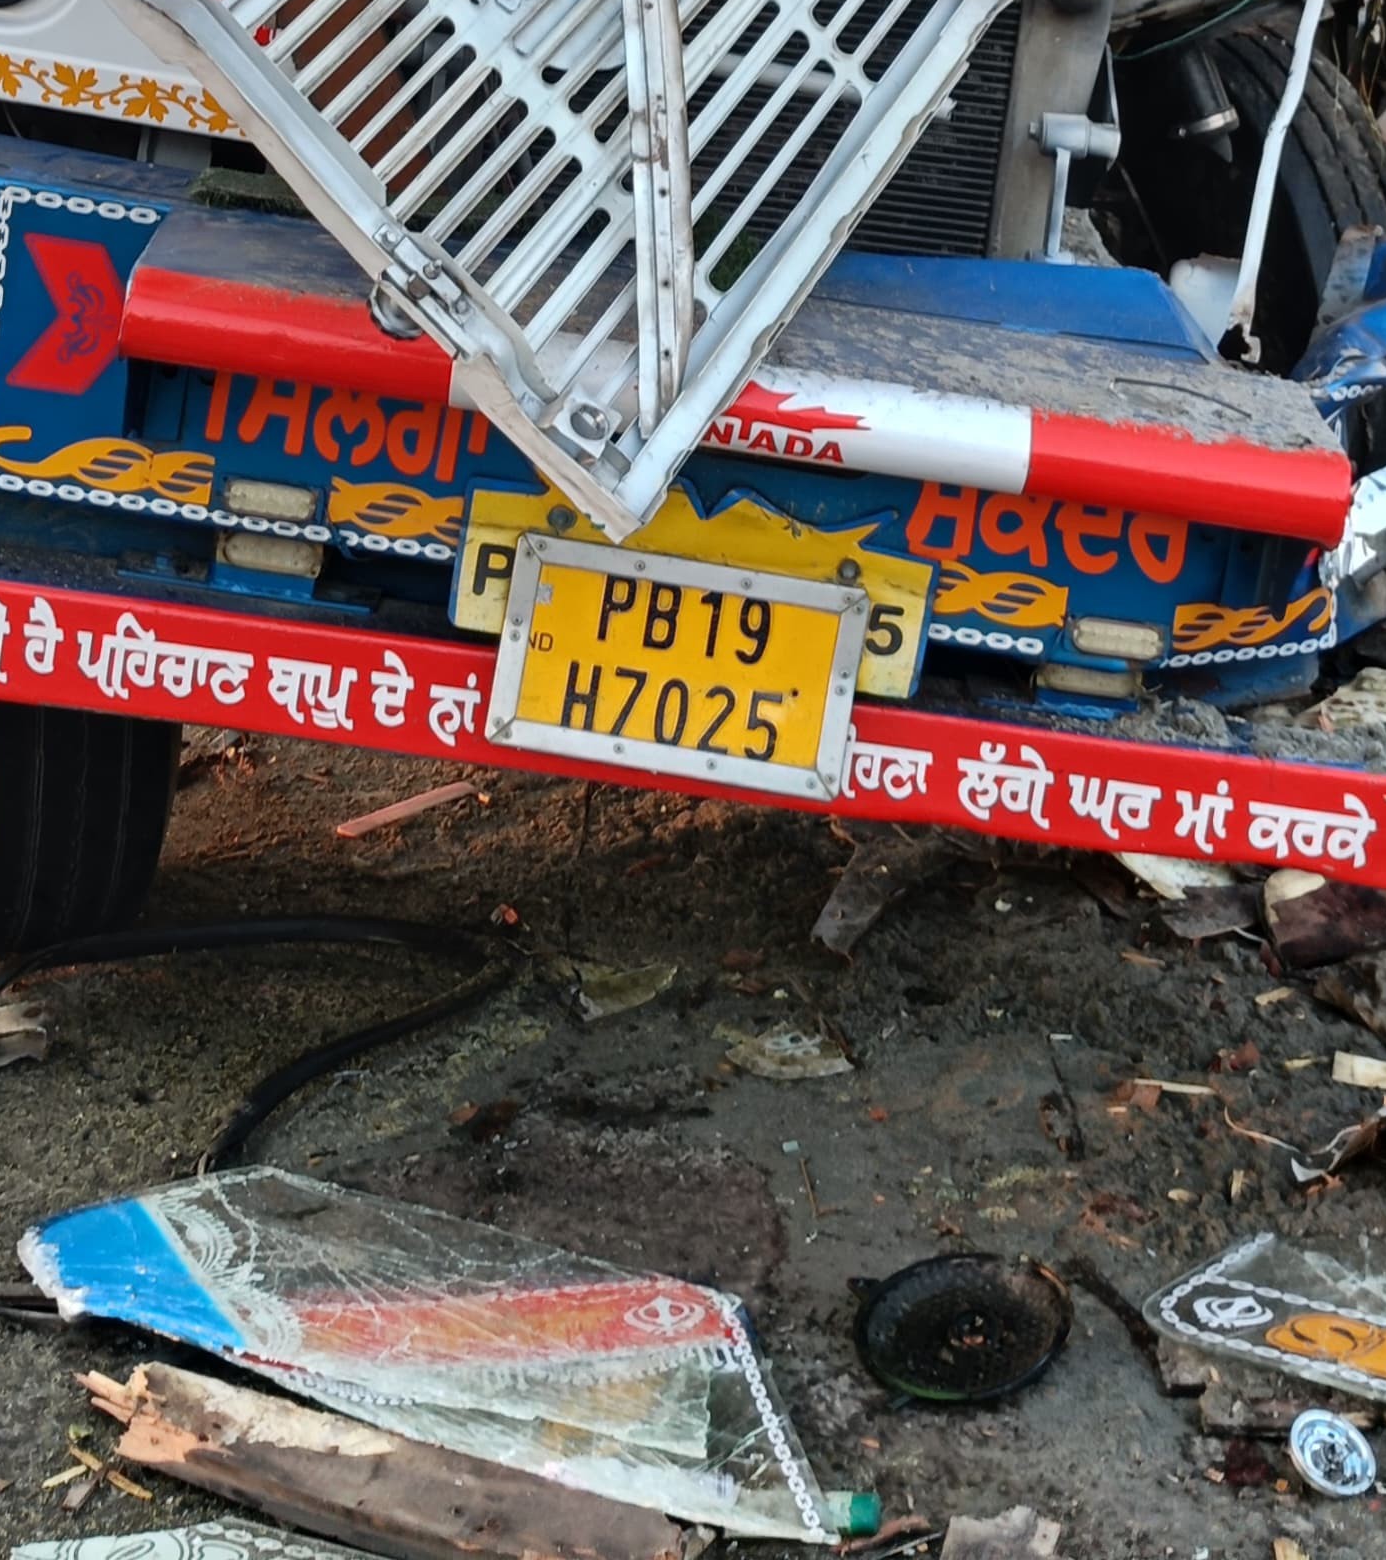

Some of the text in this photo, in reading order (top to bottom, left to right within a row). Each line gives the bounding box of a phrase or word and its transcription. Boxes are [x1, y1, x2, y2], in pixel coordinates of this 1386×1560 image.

[529, 631, 554, 652] ND
[596, 573, 772, 666] PB19
[23, 596, 64, 674] ਹੈ
[77, 612, 254, 705] ਪਹਿਚਾਣ
[268, 656, 358, 731] ਬਾਪੂ
[371, 650, 415, 727] ਦੇ
[429, 672, 481, 747] ਨਾਂ
[957, 741, 1054, 829] ਲੱਗੇ
[1069, 774, 1161, 839] ਘਰ
[1174, 780, 1234, 854] ਮਾਂ
[1248, 793, 1376, 868] ਕਰਕੇ
[560, 660, 784, 762] H7025
